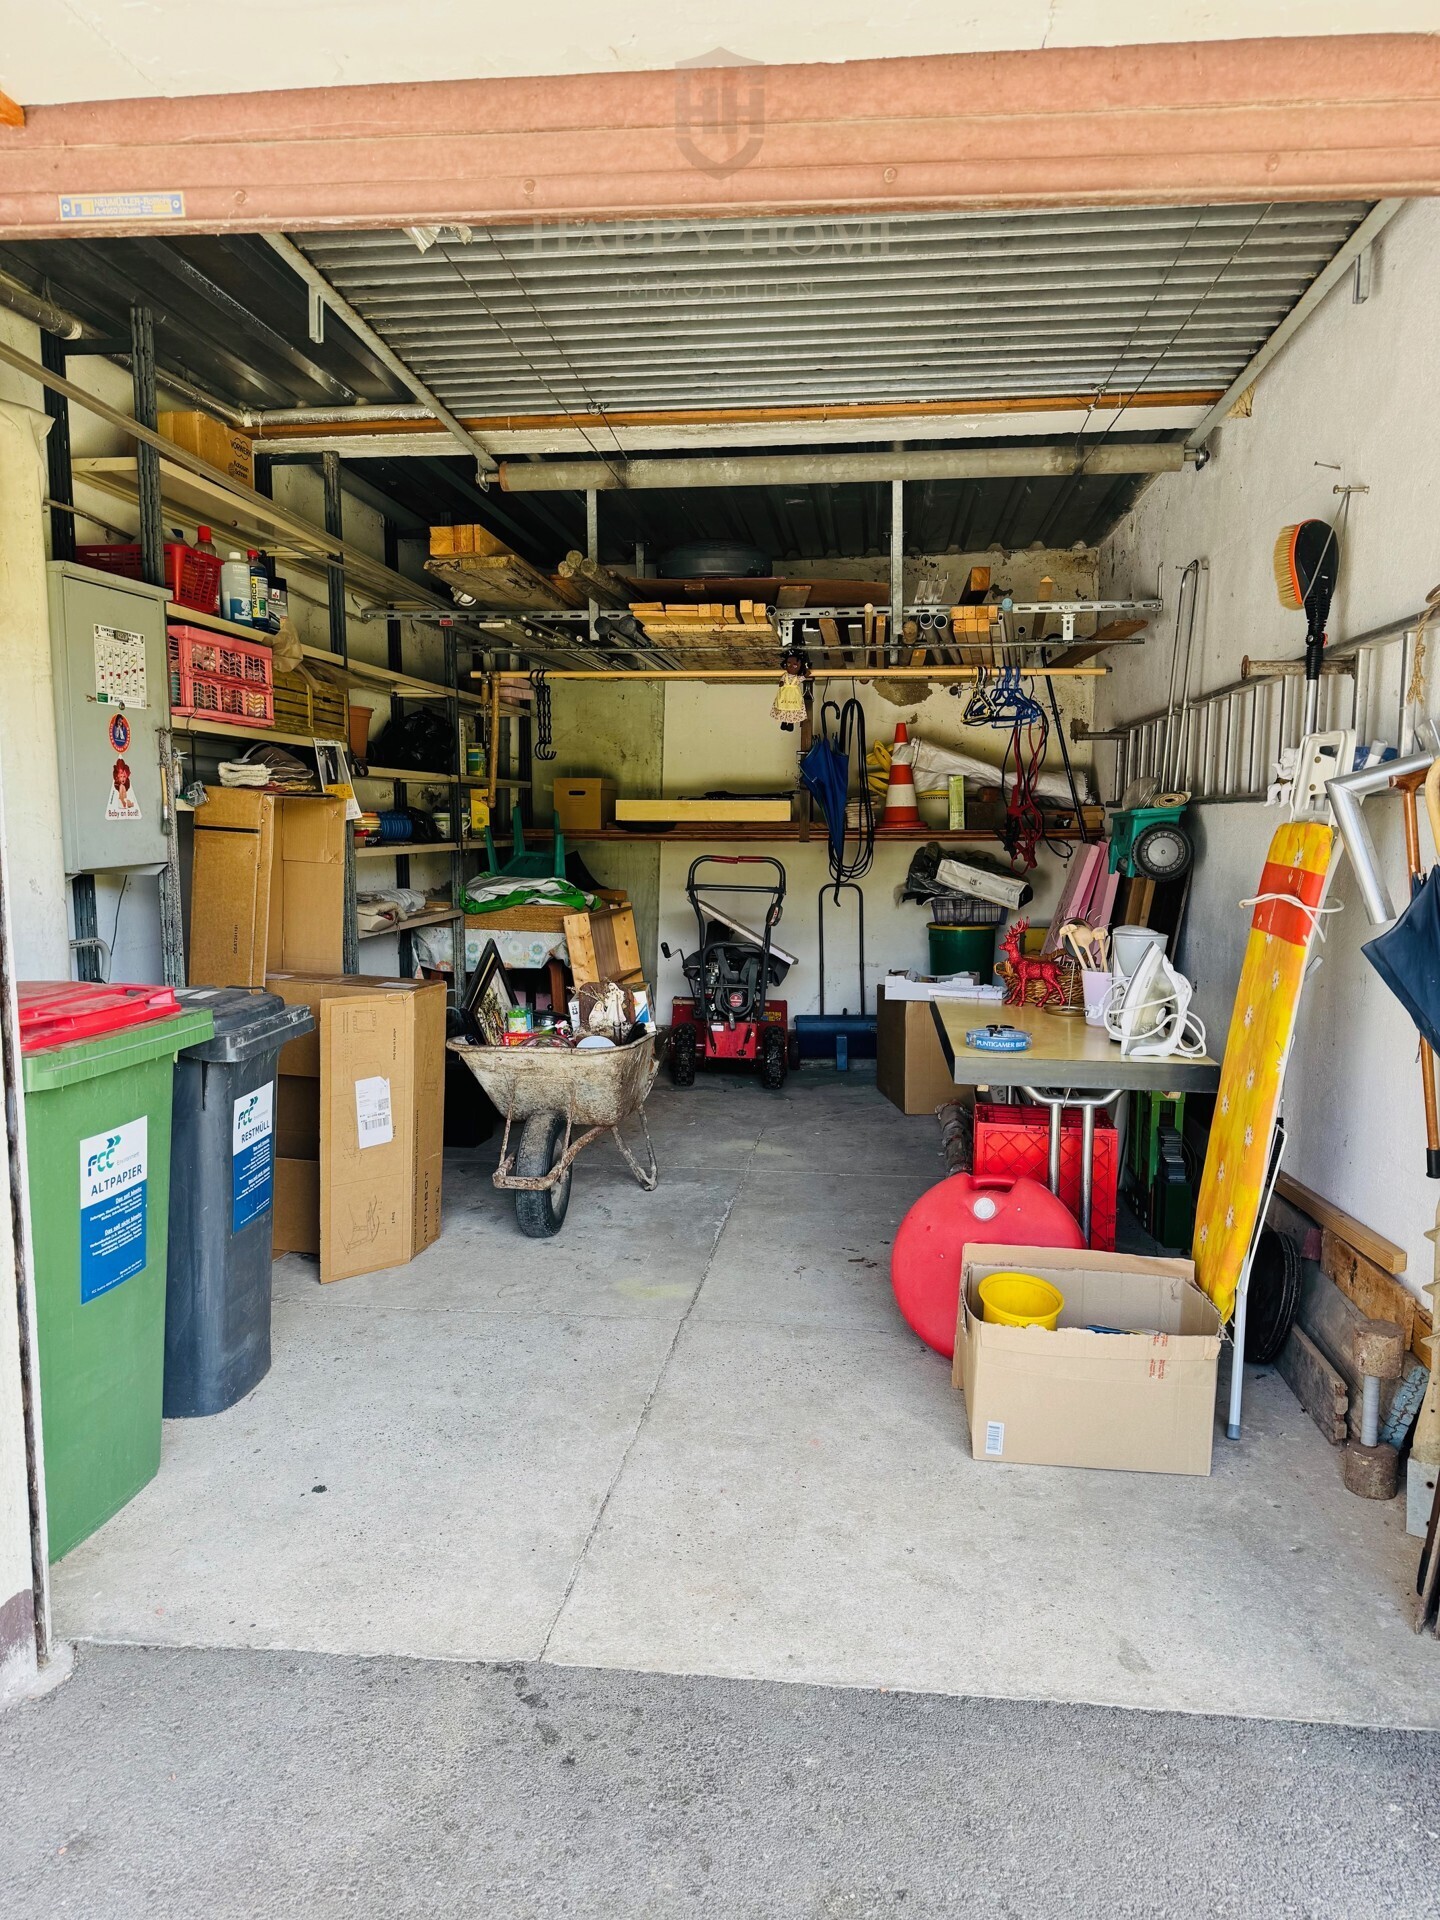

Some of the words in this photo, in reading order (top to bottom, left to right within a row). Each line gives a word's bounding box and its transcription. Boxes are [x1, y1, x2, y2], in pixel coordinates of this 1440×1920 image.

[108, 810, 120, 819] Baby
[976, 1039, 1015, 1048] PUNTIGAMER
[241, 1119, 270, 1144] RESTMÜLL
[87, 1147, 115, 1177] FCC
[91, 1164, 143, 1197] ALTPAPIER
